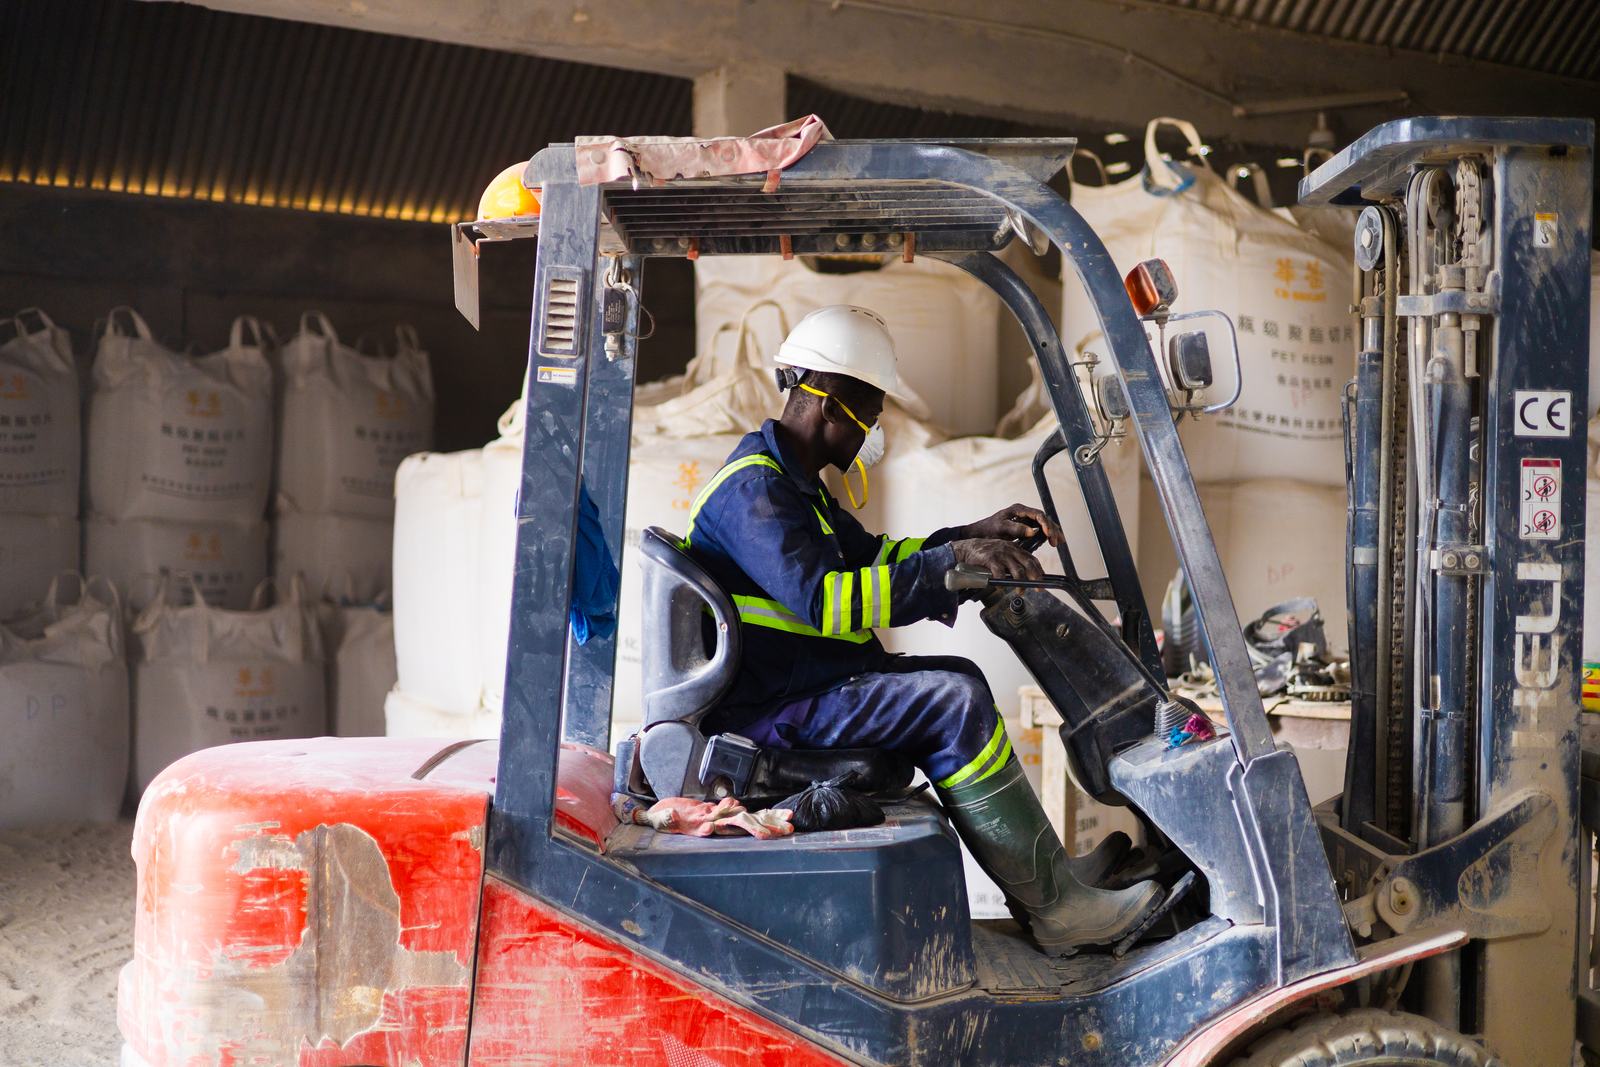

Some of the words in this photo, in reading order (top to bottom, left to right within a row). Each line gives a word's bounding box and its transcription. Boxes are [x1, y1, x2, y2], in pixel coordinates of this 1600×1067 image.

[1271, 350, 1297, 364] PET
[1519, 397, 1566, 431] CE
[1511, 562, 1562, 750] HELI
